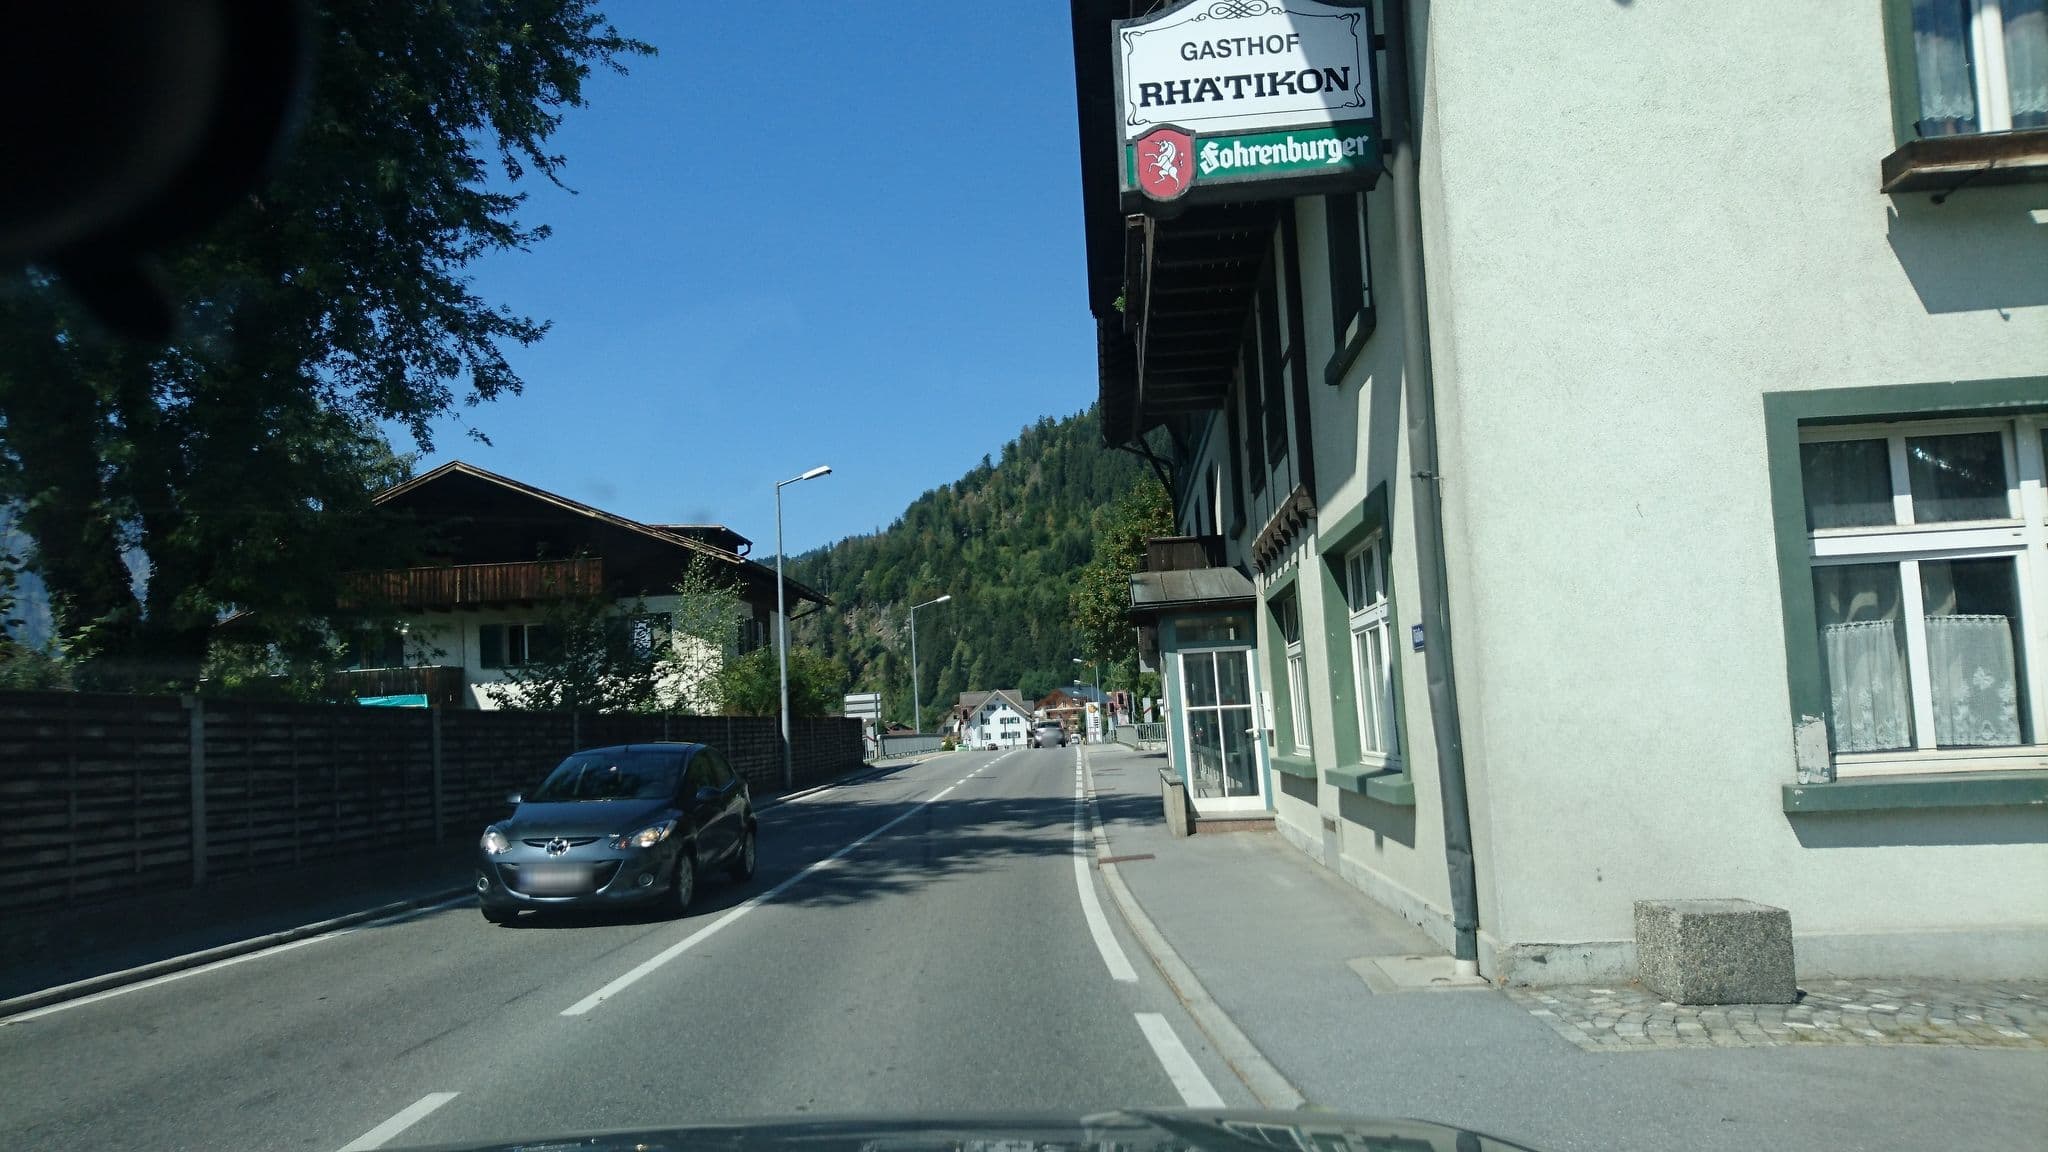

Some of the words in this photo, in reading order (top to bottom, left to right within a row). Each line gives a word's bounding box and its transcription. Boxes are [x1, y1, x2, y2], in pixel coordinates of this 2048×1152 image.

[1180, 33, 1299, 61] GASTHOF
[1139, 66, 1350, 107] RHÄTIKON
[1200, 135, 1368, 175] Fohrenburger
